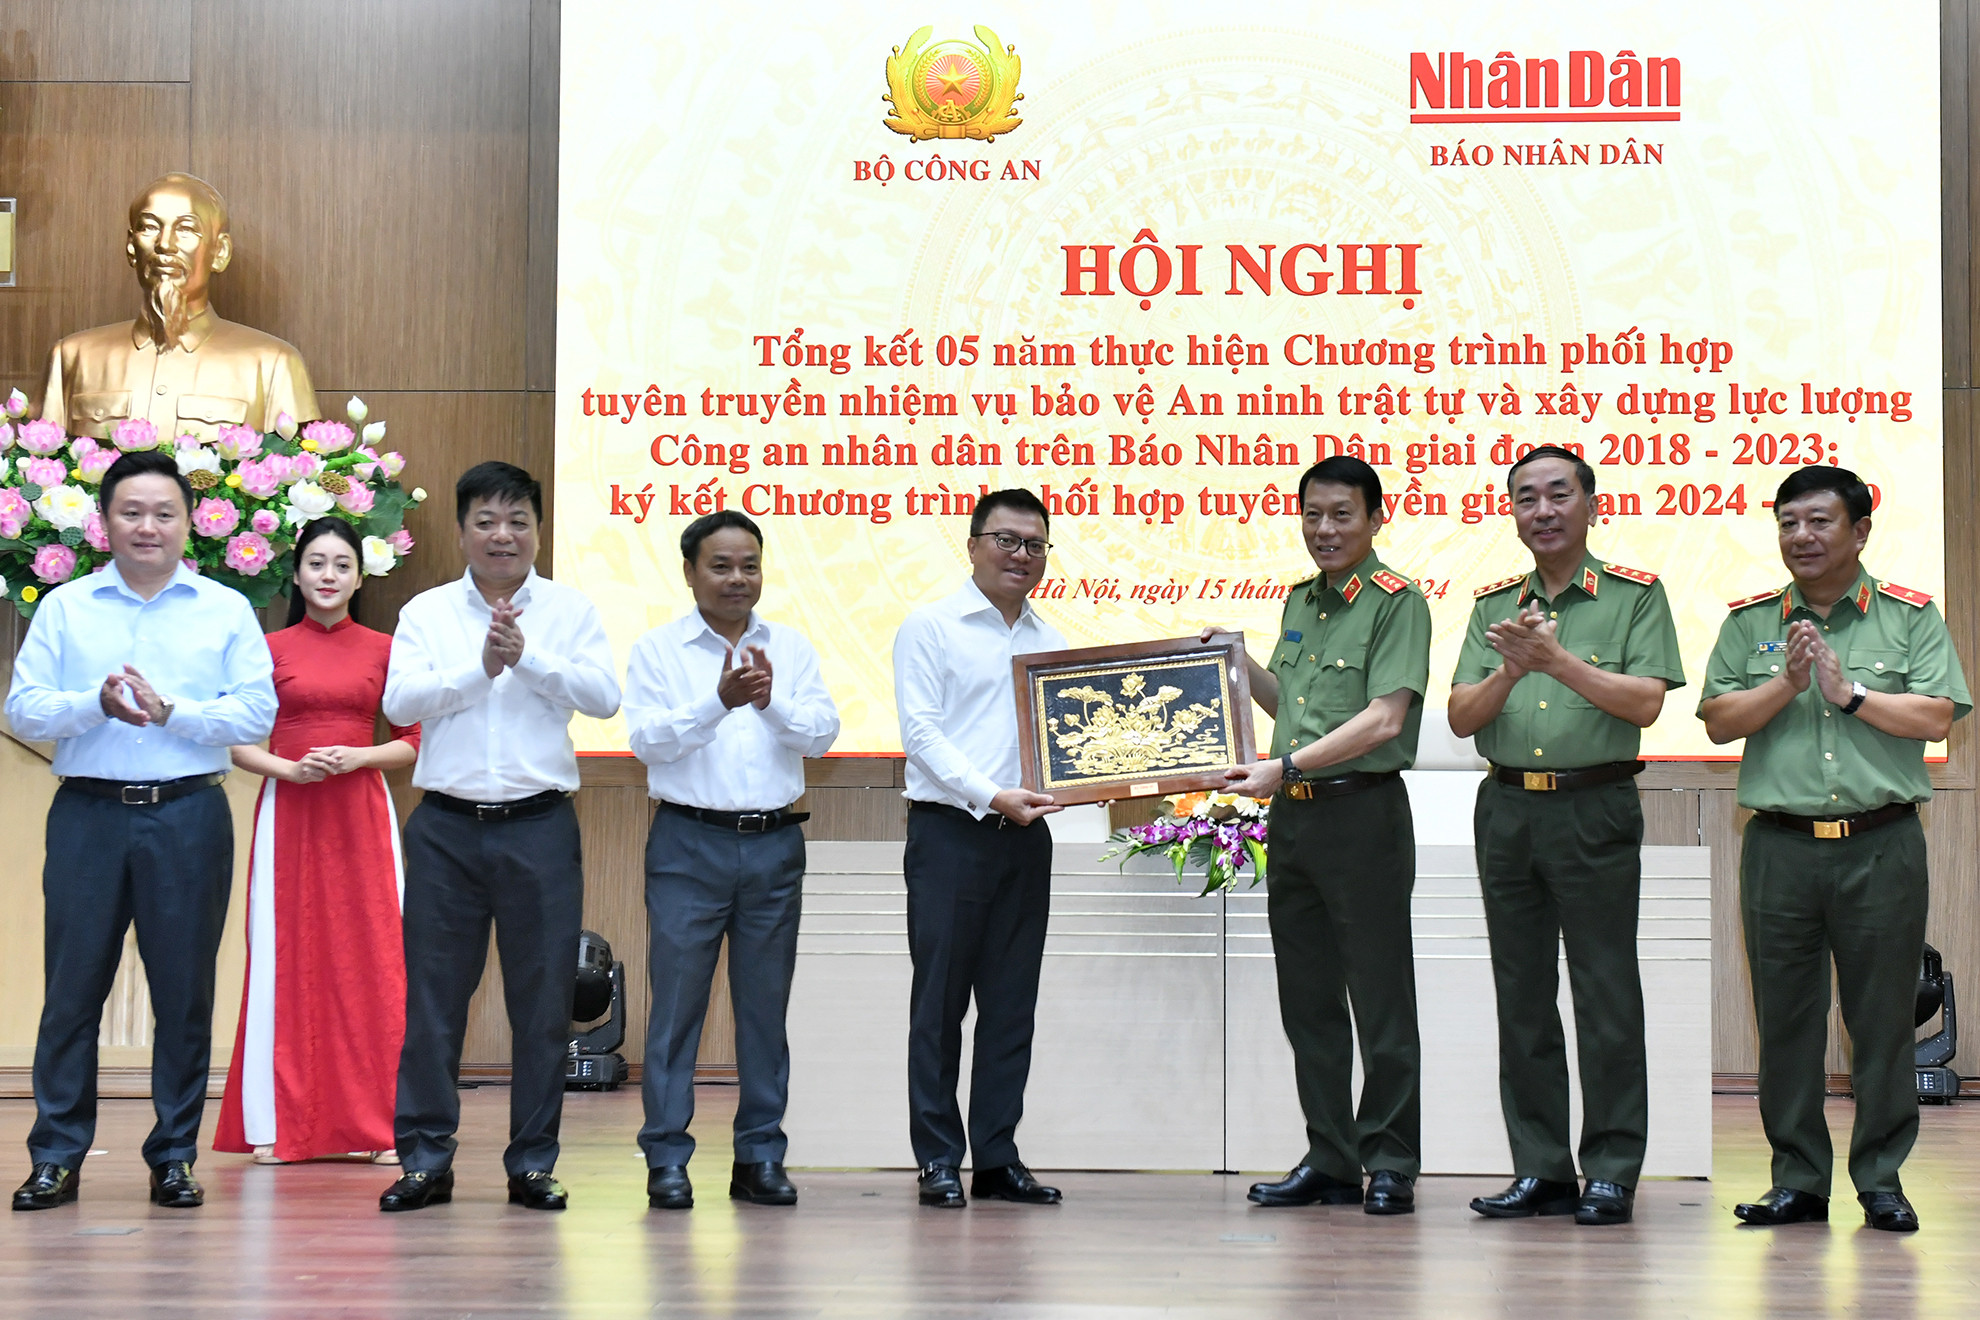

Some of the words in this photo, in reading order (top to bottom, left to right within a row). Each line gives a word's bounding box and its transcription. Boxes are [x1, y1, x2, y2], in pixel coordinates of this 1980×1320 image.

[1410, 51, 1560, 110] Nhân
[1569, 49, 1682, 108] Dân
[855, 154, 896, 187] BỘ
[905, 154, 991, 181] CÔNG
[1001, 159, 1041, 181] AN
[1432, 139, 1494, 167] BÁO
[1503, 138, 1590, 166] NHÂN
[1600, 137, 1664, 165] DÂN
[1061, 227, 1204, 311] HỘI
[1225, 243, 1423, 310] NGHỊ
[753, 327, 852, 375] Tổng
[865, 327, 924, 367] kết
[936, 334, 980, 367] 05
[994, 335, 1076, 366] năm
[1090, 334, 1175, 375] thực
[1188, 333, 1270, 375] hiện
[1284, 333, 1436, 374] Chương
[1449, 332, 1547, 366] trình
[1561, 325, 1647, 374] phối
[1661, 332, 1734, 373] hợp
[582, 383, 688, 425] tuyên
[701, 377, 827, 425] truyền
[840, 383, 959, 425] nhiệm
[972, 393, 1018, 425] vụ
[1031, 382, 1101, 417] bảo
[1114, 382, 1155, 425] vệ
[1168, 384, 1224, 416] An
[1238, 383, 1325, 416] ninh
[1338, 382, 1412, 425] trật
[1424, 386, 1466, 425] tự
[1478, 382, 1522, 416] và
[1535, 382, 1604, 424] xây
[1617, 383, 1717, 424] dựng
[1729, 382, 1788, 424] lực
[1802, 382, 1913, 423] lượng
[650, 433, 751, 474] Công
[763, 443, 809, 466] an
[823, 433, 919, 466] nhân
[931, 433, 1003, 466] dân
[1016, 432, 1096, 466] trên
[1109, 432, 1183, 466] Báo
[1196, 432, 1300, 466] Nhân
[1313, 432, 1393, 466] Dân
[1405, 433, 1477, 474] giai
[1600, 433, 1691, 466] 2018
[1705, 450, 1719, 458] -
[1733, 432, 1839, 468] 2023;
[610, 482, 656, 524] ký
[670, 476, 728, 516] kết
[742, 483, 892, 524] Chương
[1041, 476, 1100, 516] hối
[1113, 484, 1185, 525] hợp
[1199, 482, 1302, 525] tuyên
[1461, 483, 1514, 525] gia
[1656, 483, 1748, 516] 2024
[1029, 578, 1067, 599] Hà
[1072, 578, 1122, 605] Nội,
[1130, 578, 1190, 605] ngày
[1198, 578, 1227, 600] 15
